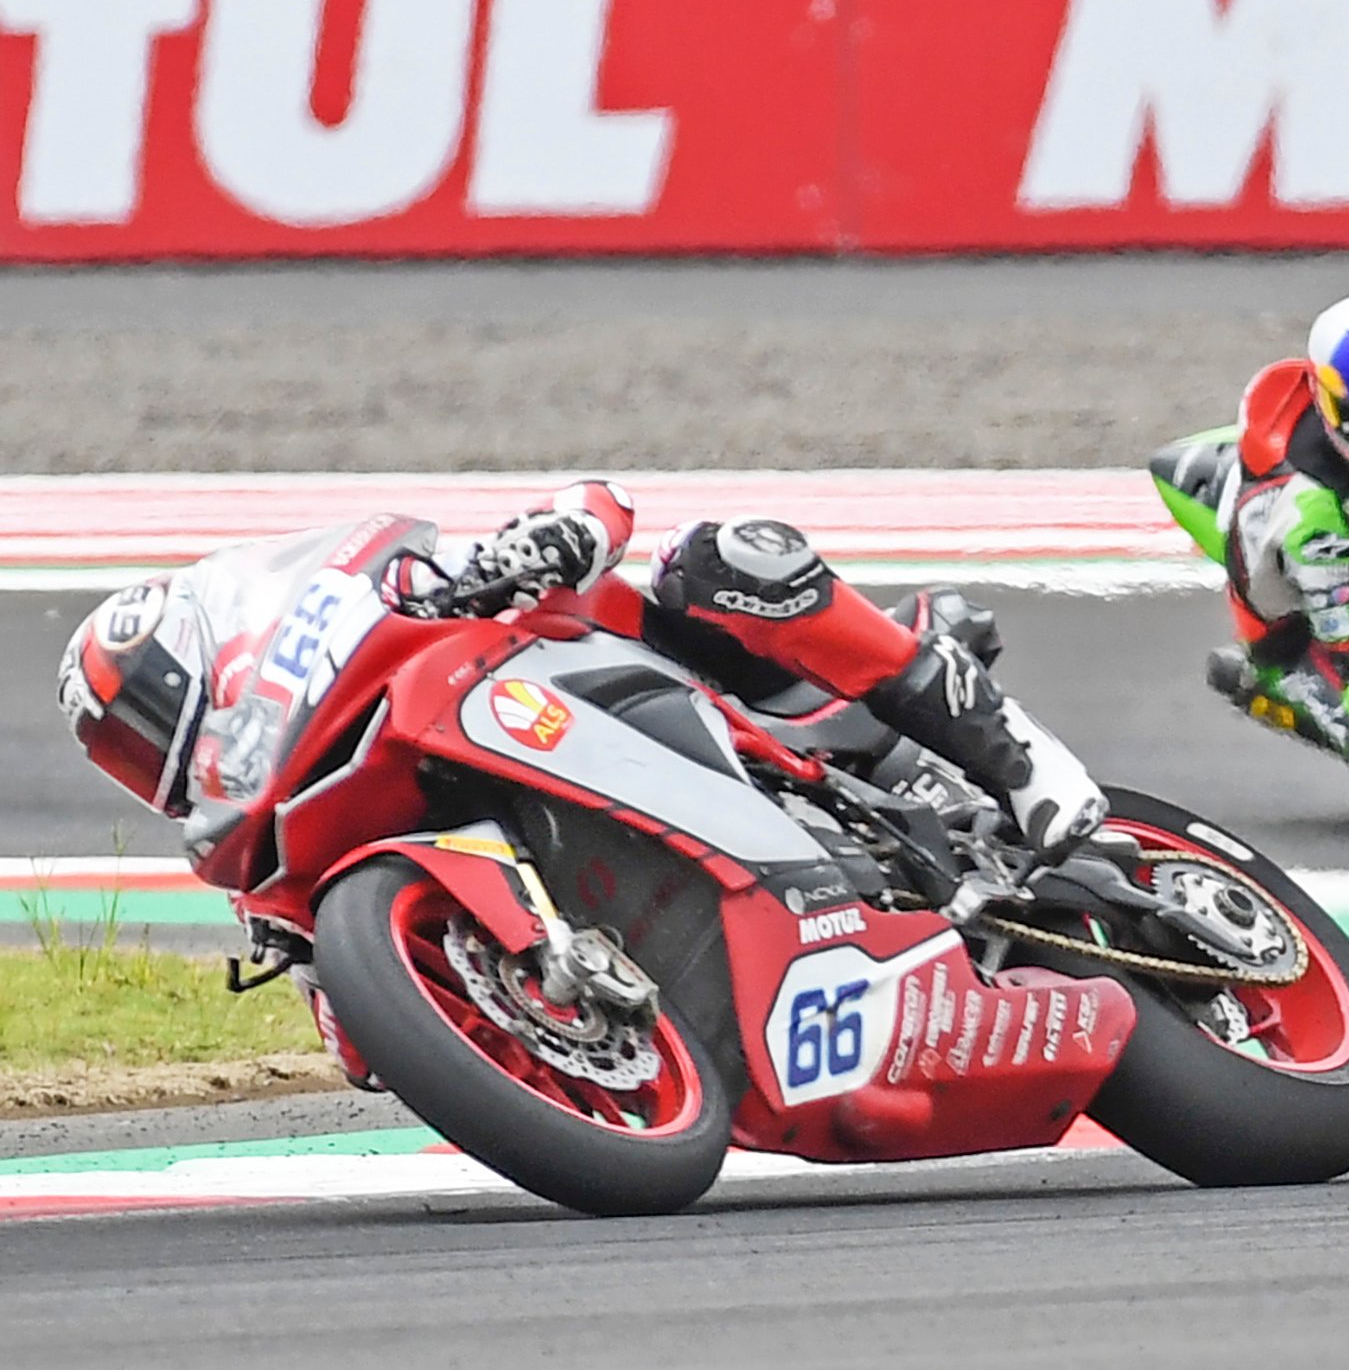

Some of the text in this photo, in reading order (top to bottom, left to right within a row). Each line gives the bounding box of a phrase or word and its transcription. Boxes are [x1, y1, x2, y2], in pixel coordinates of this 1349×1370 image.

[533, 703, 568, 746] ALS
[798, 907, 868, 945] MOTUL
[787, 978, 870, 1089] 66
